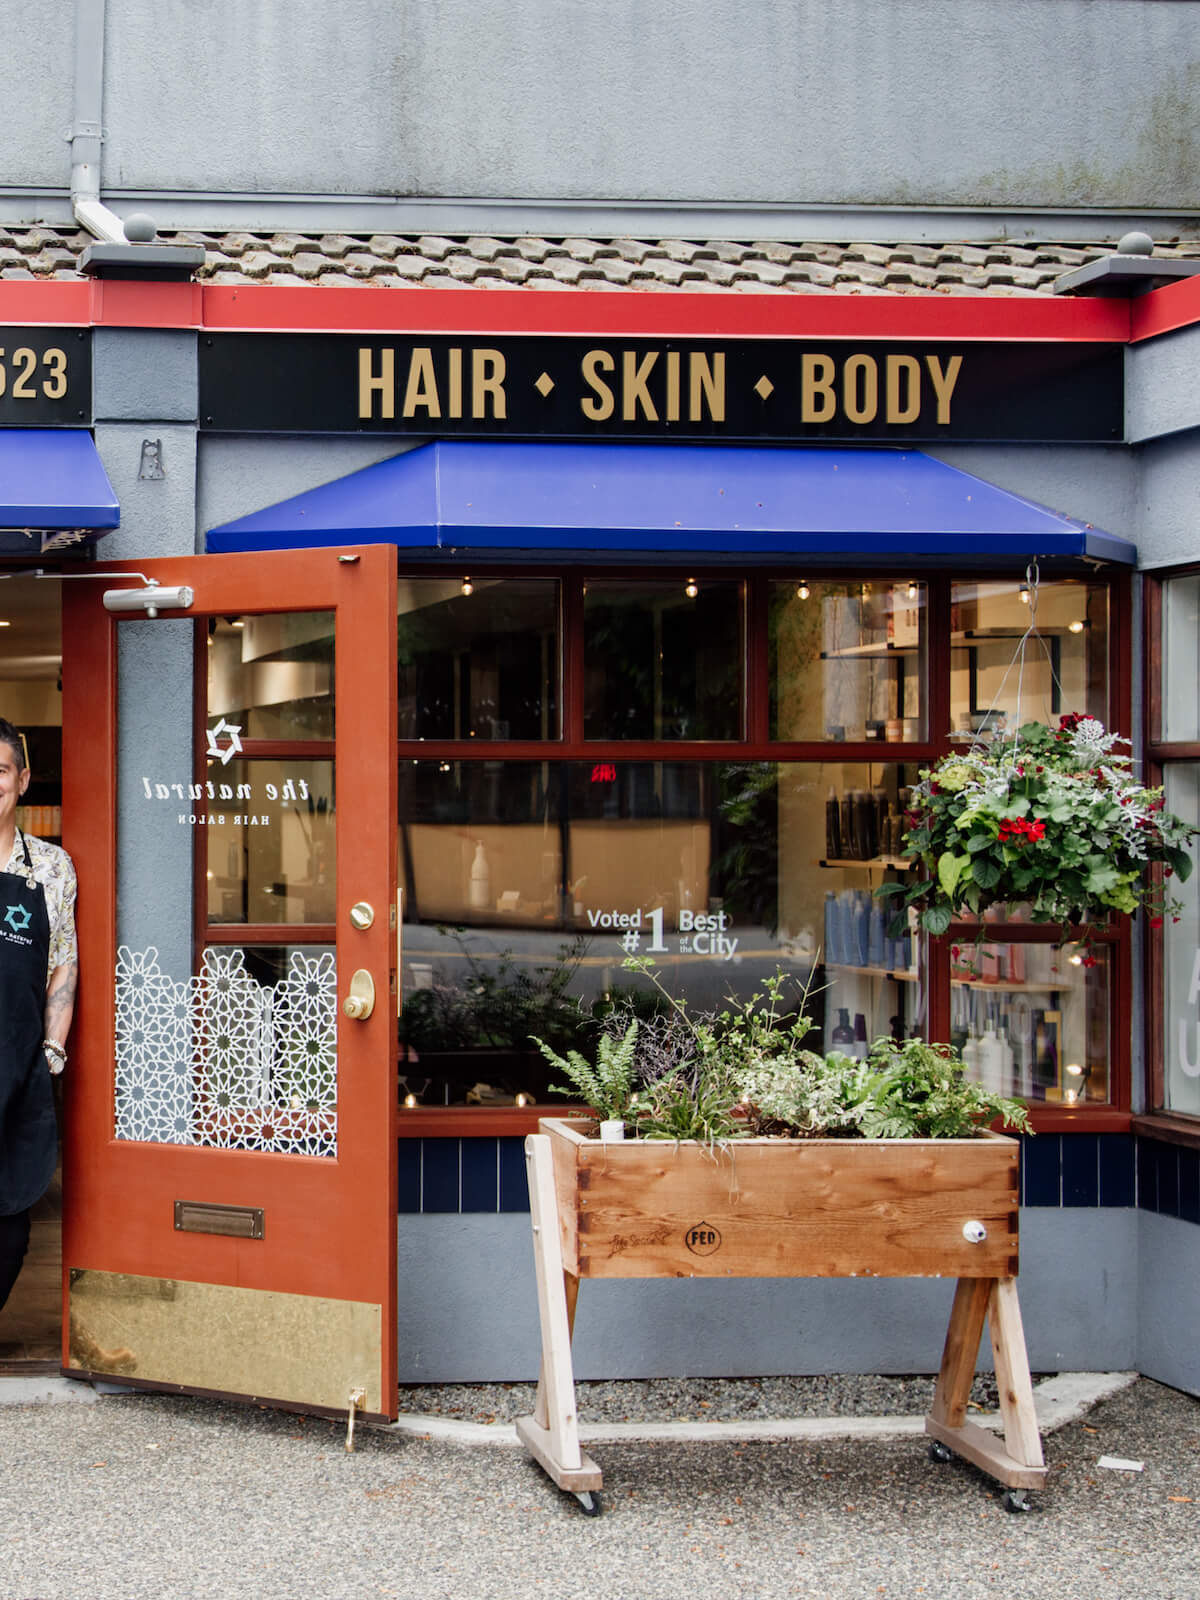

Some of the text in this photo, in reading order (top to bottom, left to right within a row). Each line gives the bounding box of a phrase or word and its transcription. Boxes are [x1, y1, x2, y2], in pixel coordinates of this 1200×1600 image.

[358, 348, 963, 425] HAIR SKIN BODY
[587, 908, 641, 928] Voted
[679, 909, 726, 932] Best
[692, 932, 739, 961] City
[691, 1231, 716, 1246] FED
